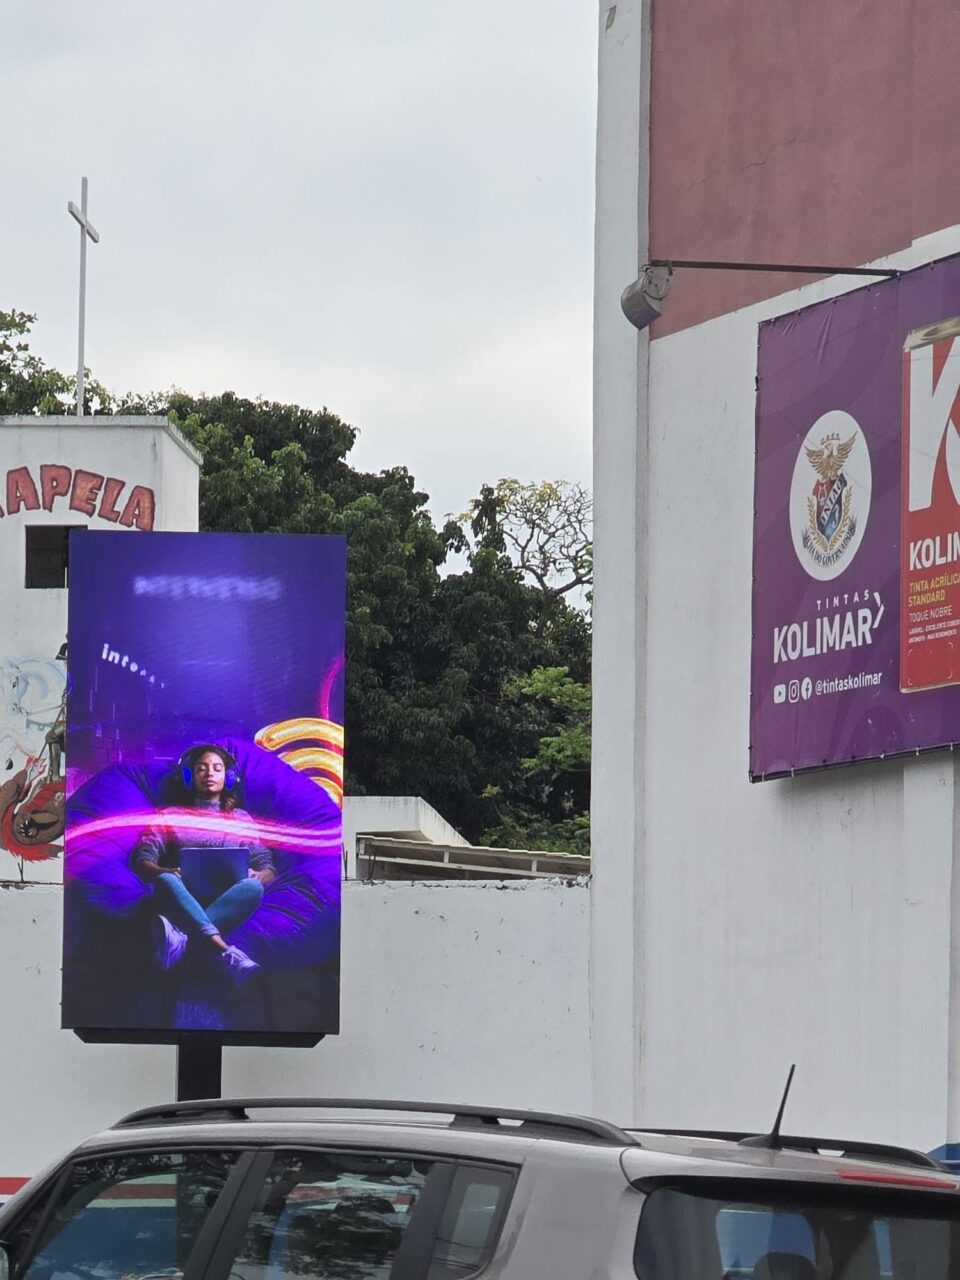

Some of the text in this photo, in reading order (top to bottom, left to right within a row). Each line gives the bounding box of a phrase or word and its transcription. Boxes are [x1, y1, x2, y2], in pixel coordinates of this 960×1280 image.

[909, 572, 960, 594] TINTA ACRÍLIC
[816, 589, 870, 611] TINTAS
[908, 589, 946, 607] STANDARD
[909, 609, 929, 623] TOQUE
[930, 604, 953, 619] NOBRE
[773, 607, 873, 664] KOLIMAR
[815, 672, 883, 696] @tintaskolimar
